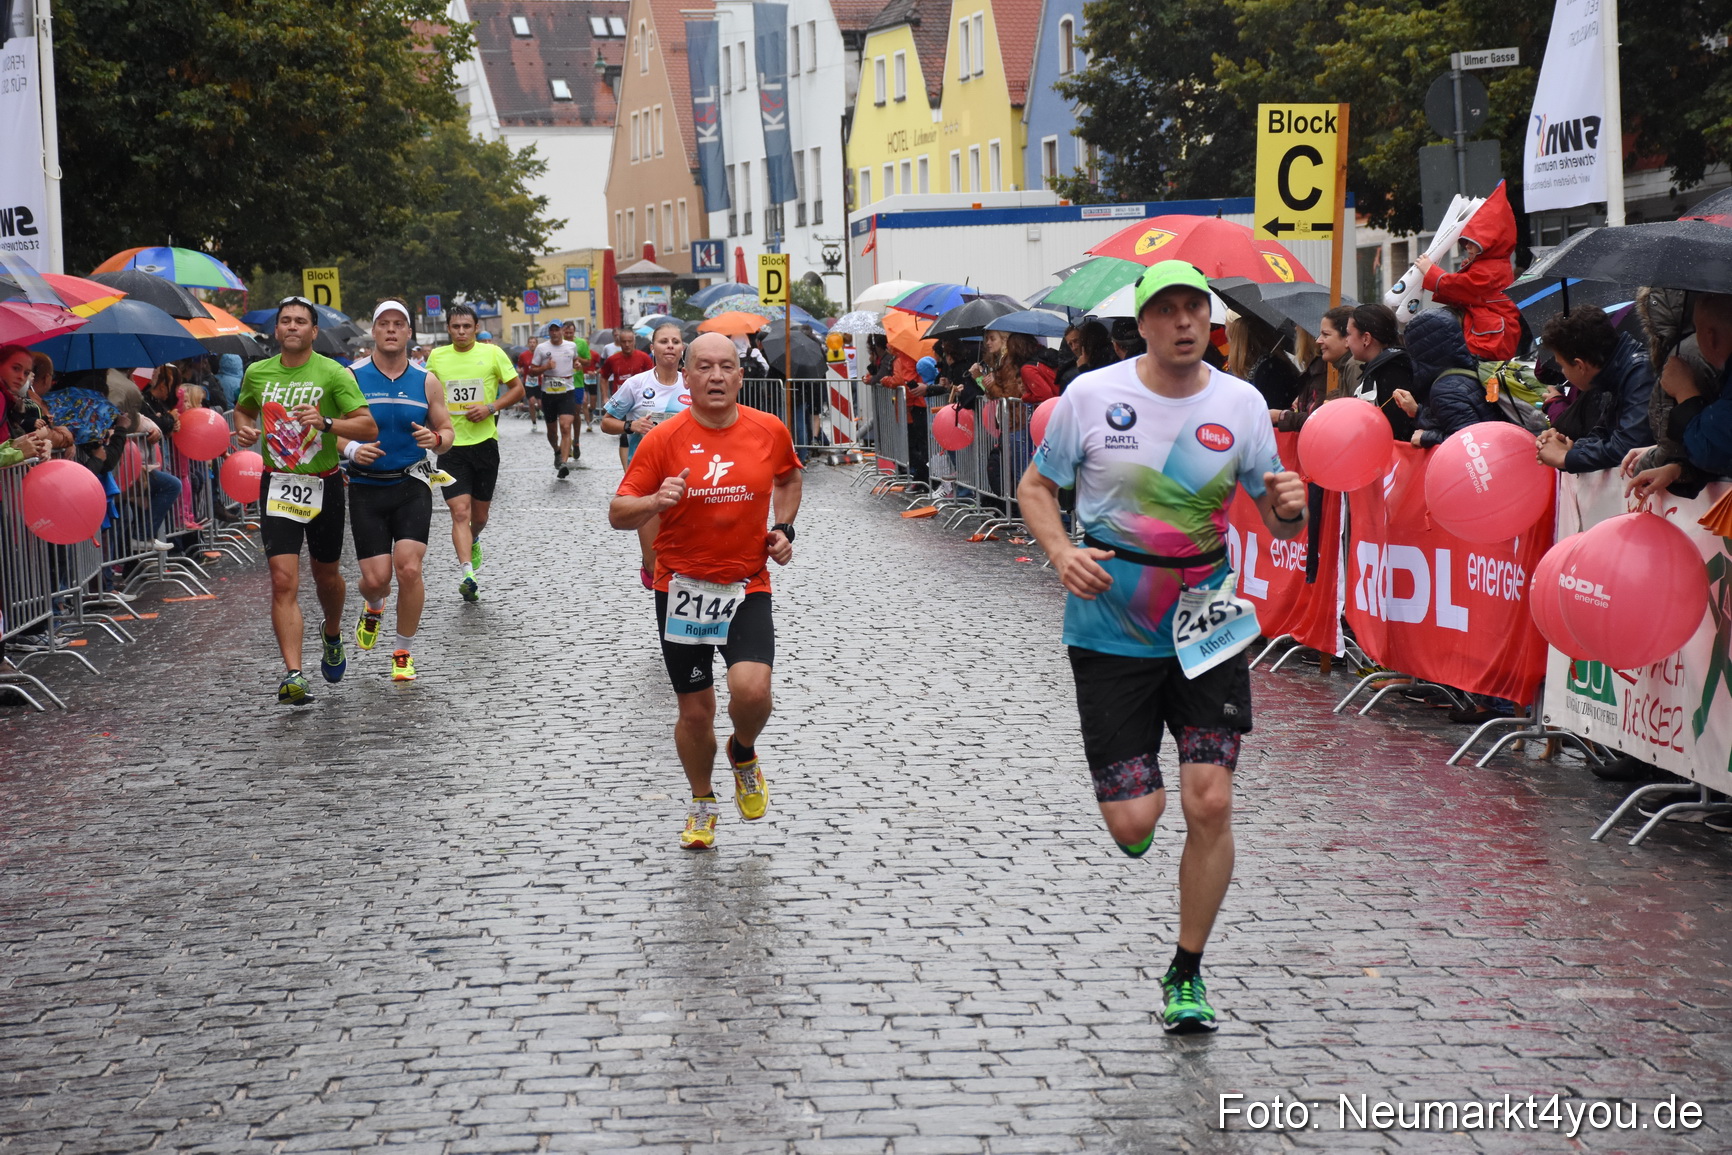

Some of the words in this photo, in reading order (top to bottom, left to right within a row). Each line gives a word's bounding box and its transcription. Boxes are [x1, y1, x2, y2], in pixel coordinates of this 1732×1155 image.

[1464, 54, 1488, 66] Ulmer
[1491, 52, 1516, 64] Gasse
[1268, 109, 1338, 134] Block
[887, 129, 909, 154] HOTEL
[1277, 144, 1324, 212] C
[761, 256, 786, 266] Block
[307, 270, 335, 281] Block
[766, 269, 782, 295] D
[313, 284, 332, 306] D
[261, 381, 324, 408] HELFER
[453, 387, 477, 402] 337
[1105, 435, 1139, 444] PARTL
[1201, 427, 1231, 446] Hervis
[280, 484, 313, 505] 292
[687, 485, 747, 499] funrunners
[704, 491, 754, 504] neumarkt
[277, 503, 311, 517] Ferdinand
[1467, 549, 1526, 602] energie
[674, 590, 736, 620] 2144
[1574, 593, 1609, 609] energie
[685, 623, 719, 637] Roland
